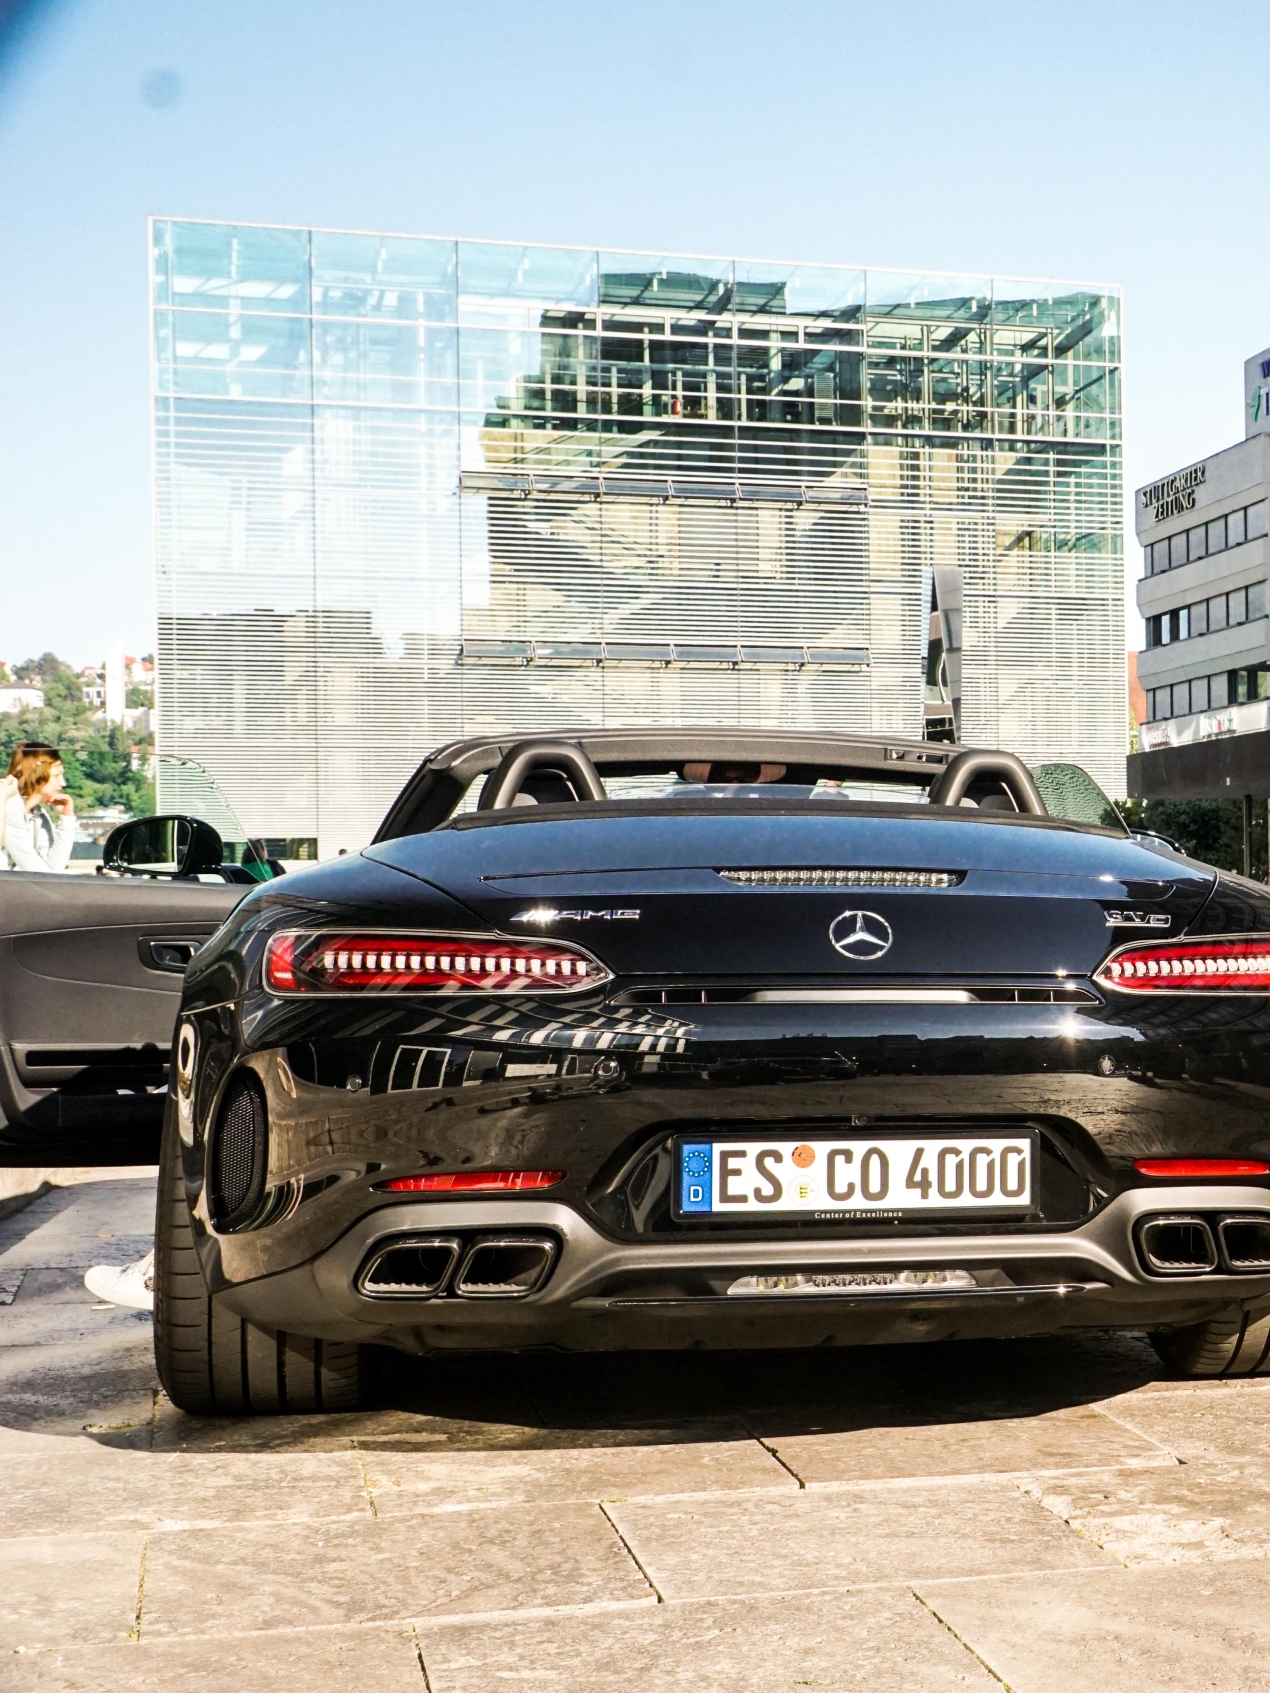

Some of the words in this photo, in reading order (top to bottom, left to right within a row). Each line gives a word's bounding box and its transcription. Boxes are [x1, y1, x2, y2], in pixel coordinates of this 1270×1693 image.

[1141, 465, 1206, 508] STUTTGARTER
[1152, 489, 1195, 522] ZEITUNG
[556, 909, 640, 921] AMG
[689, 1186, 703, 1202] D
[718, 1149, 784, 1204] ES
[826, 1146, 890, 1202] CO
[905, 1146, 1027, 1200] 4000
